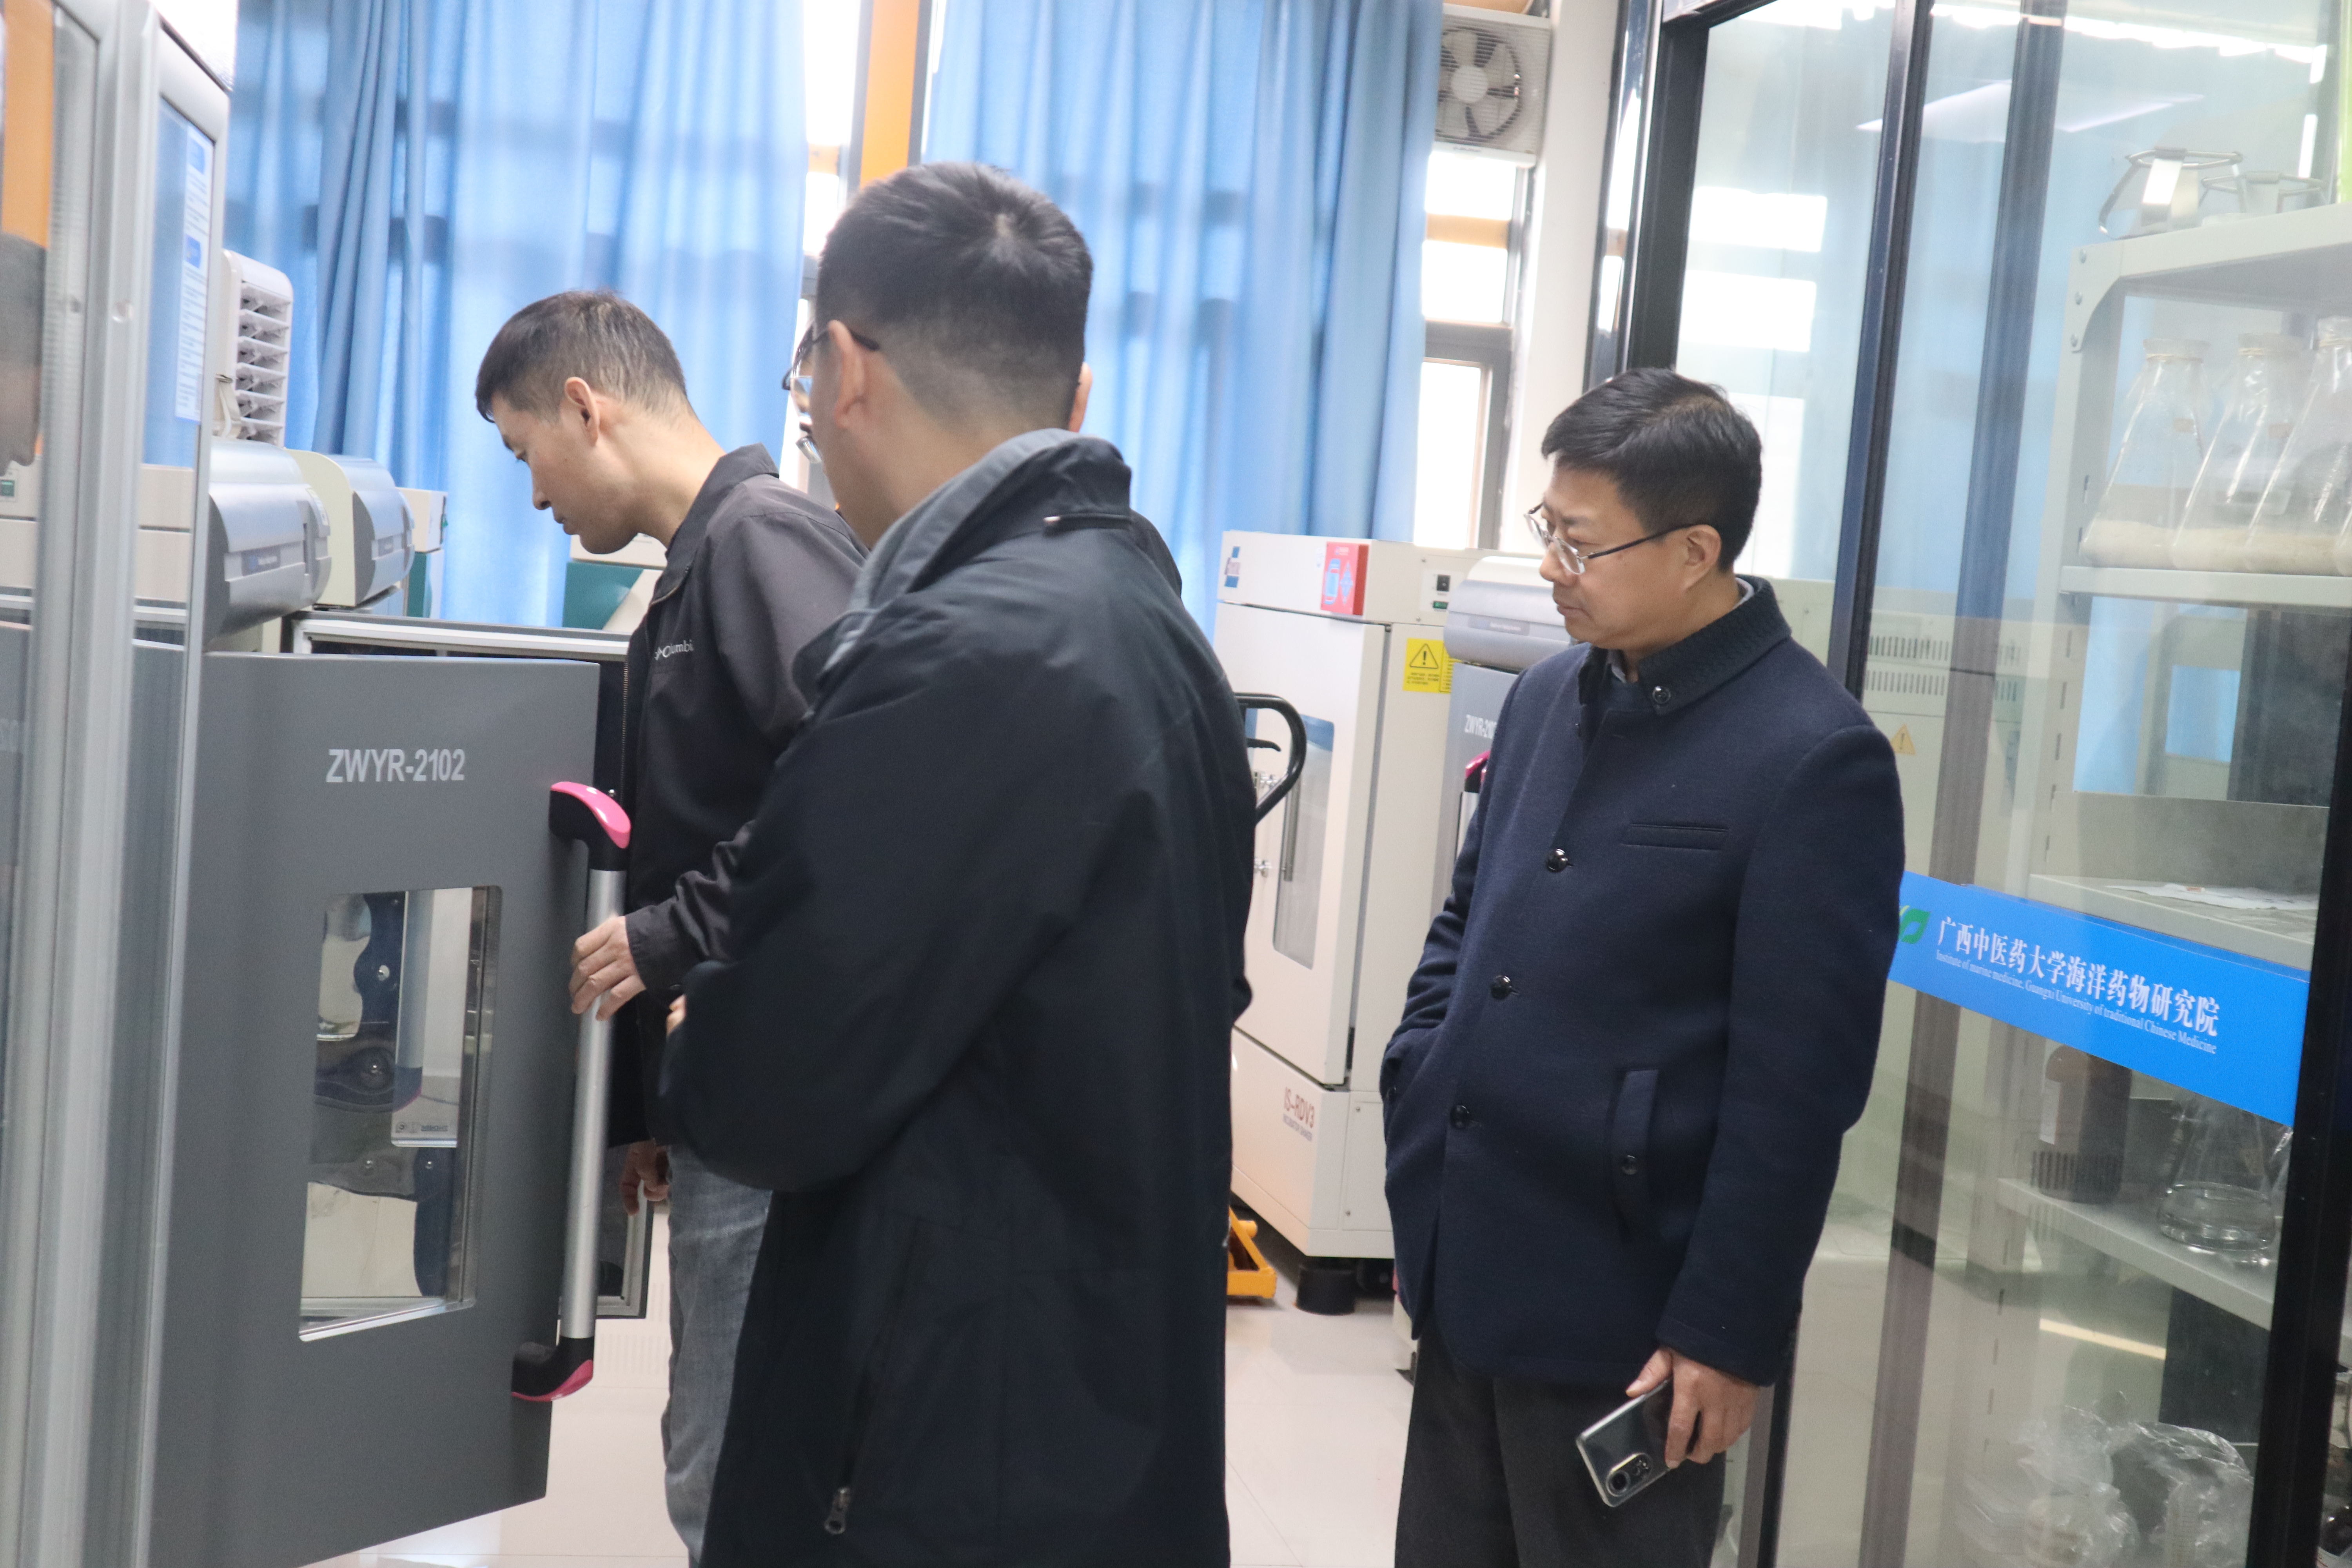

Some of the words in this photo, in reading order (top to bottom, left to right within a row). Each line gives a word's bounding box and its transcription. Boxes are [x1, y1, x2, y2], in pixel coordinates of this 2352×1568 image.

[325, 749, 466, 783] ZWYR-2102
[1938, 916, 2220, 1037] 广西中医药大学海洋药物研究院
[1962, 959, 1971, 970] of
[2025, 979, 2055, 1000] Guangxi
[2056, 988, 2094, 1015] University
[2094, 1003, 2105, 1016] of
[2103, 1008, 2144, 1030] traditional
[2144, 1019, 2177, 1040] Chinese
[2177, 1030, 2217, 1054] Medicine
